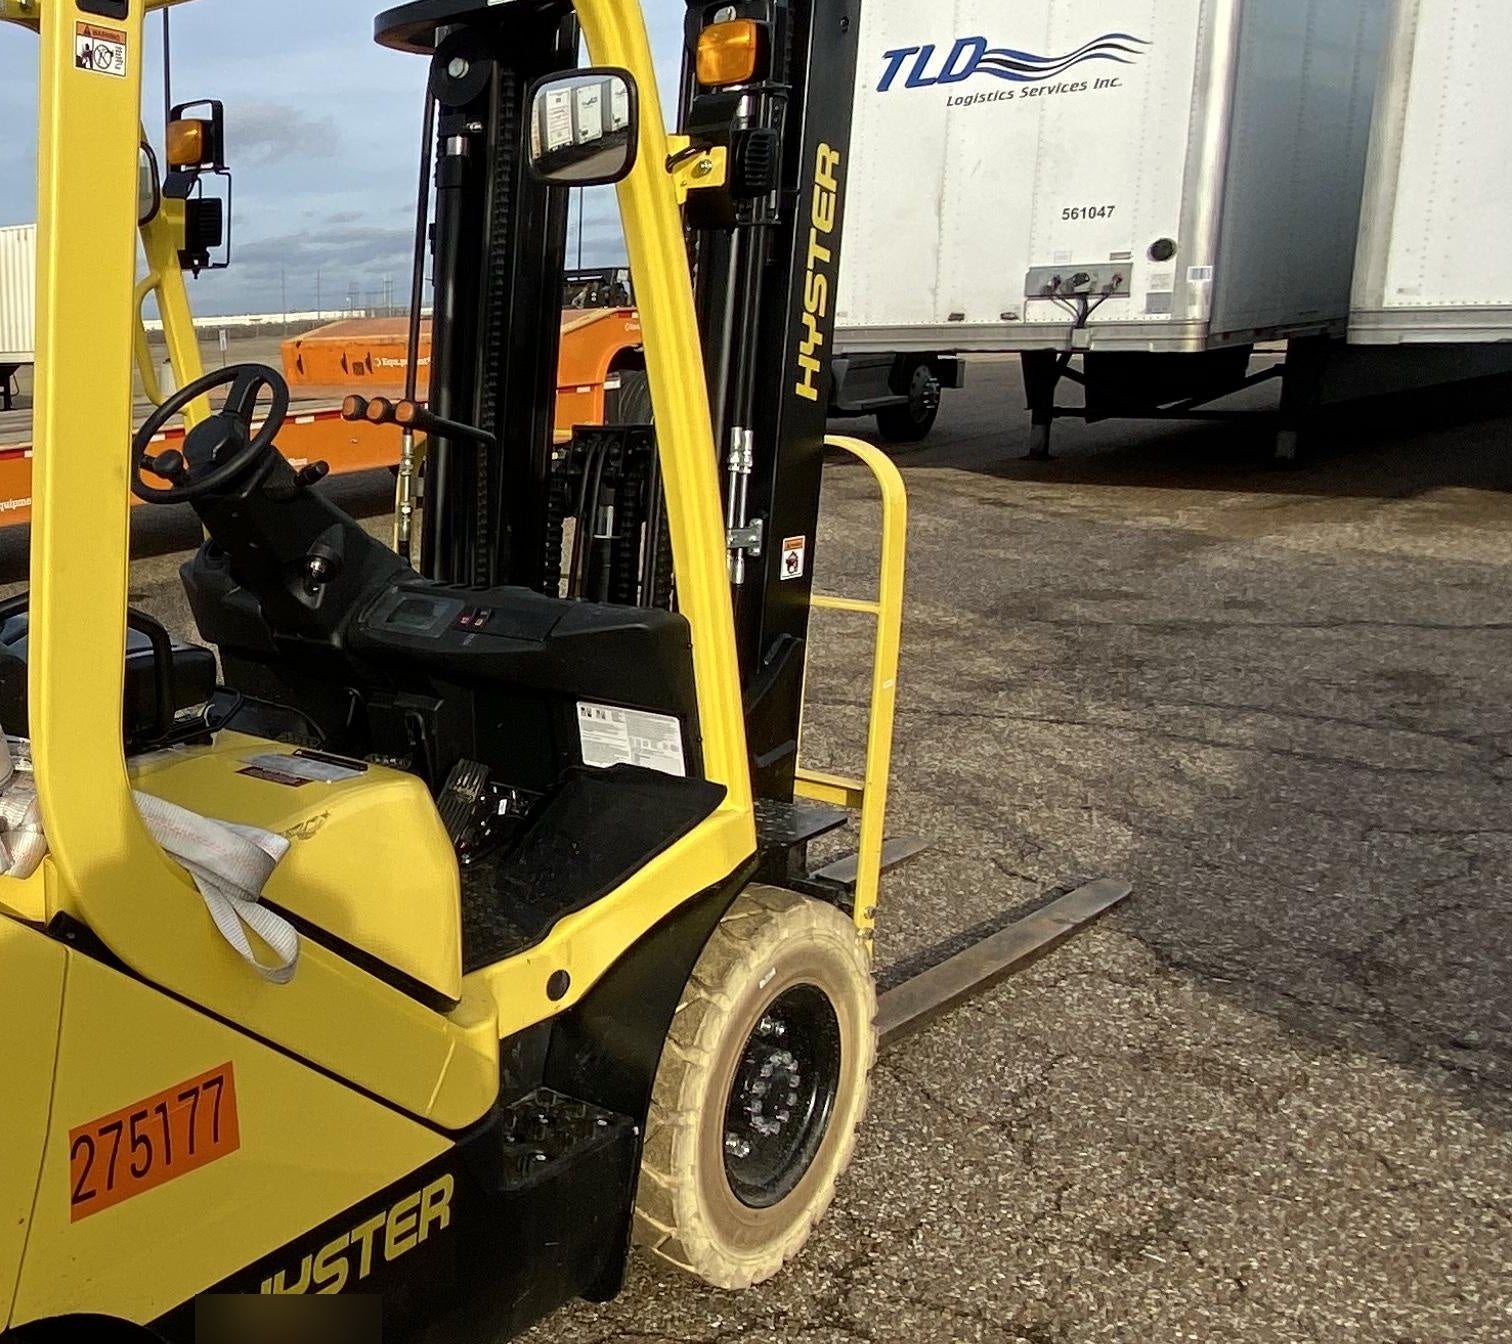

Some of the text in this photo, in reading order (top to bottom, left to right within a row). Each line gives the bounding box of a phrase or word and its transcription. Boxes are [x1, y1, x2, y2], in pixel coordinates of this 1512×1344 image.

[876, 36, 988, 93] TLD
[946, 76, 1124, 108] Logistics Services Inc.
[1061, 205, 1116, 221] 561047
[795, 142, 840, 402] HYSTER
[69, 1074, 225, 1207] 275177
[260, 1172, 455, 1294] YSTER
